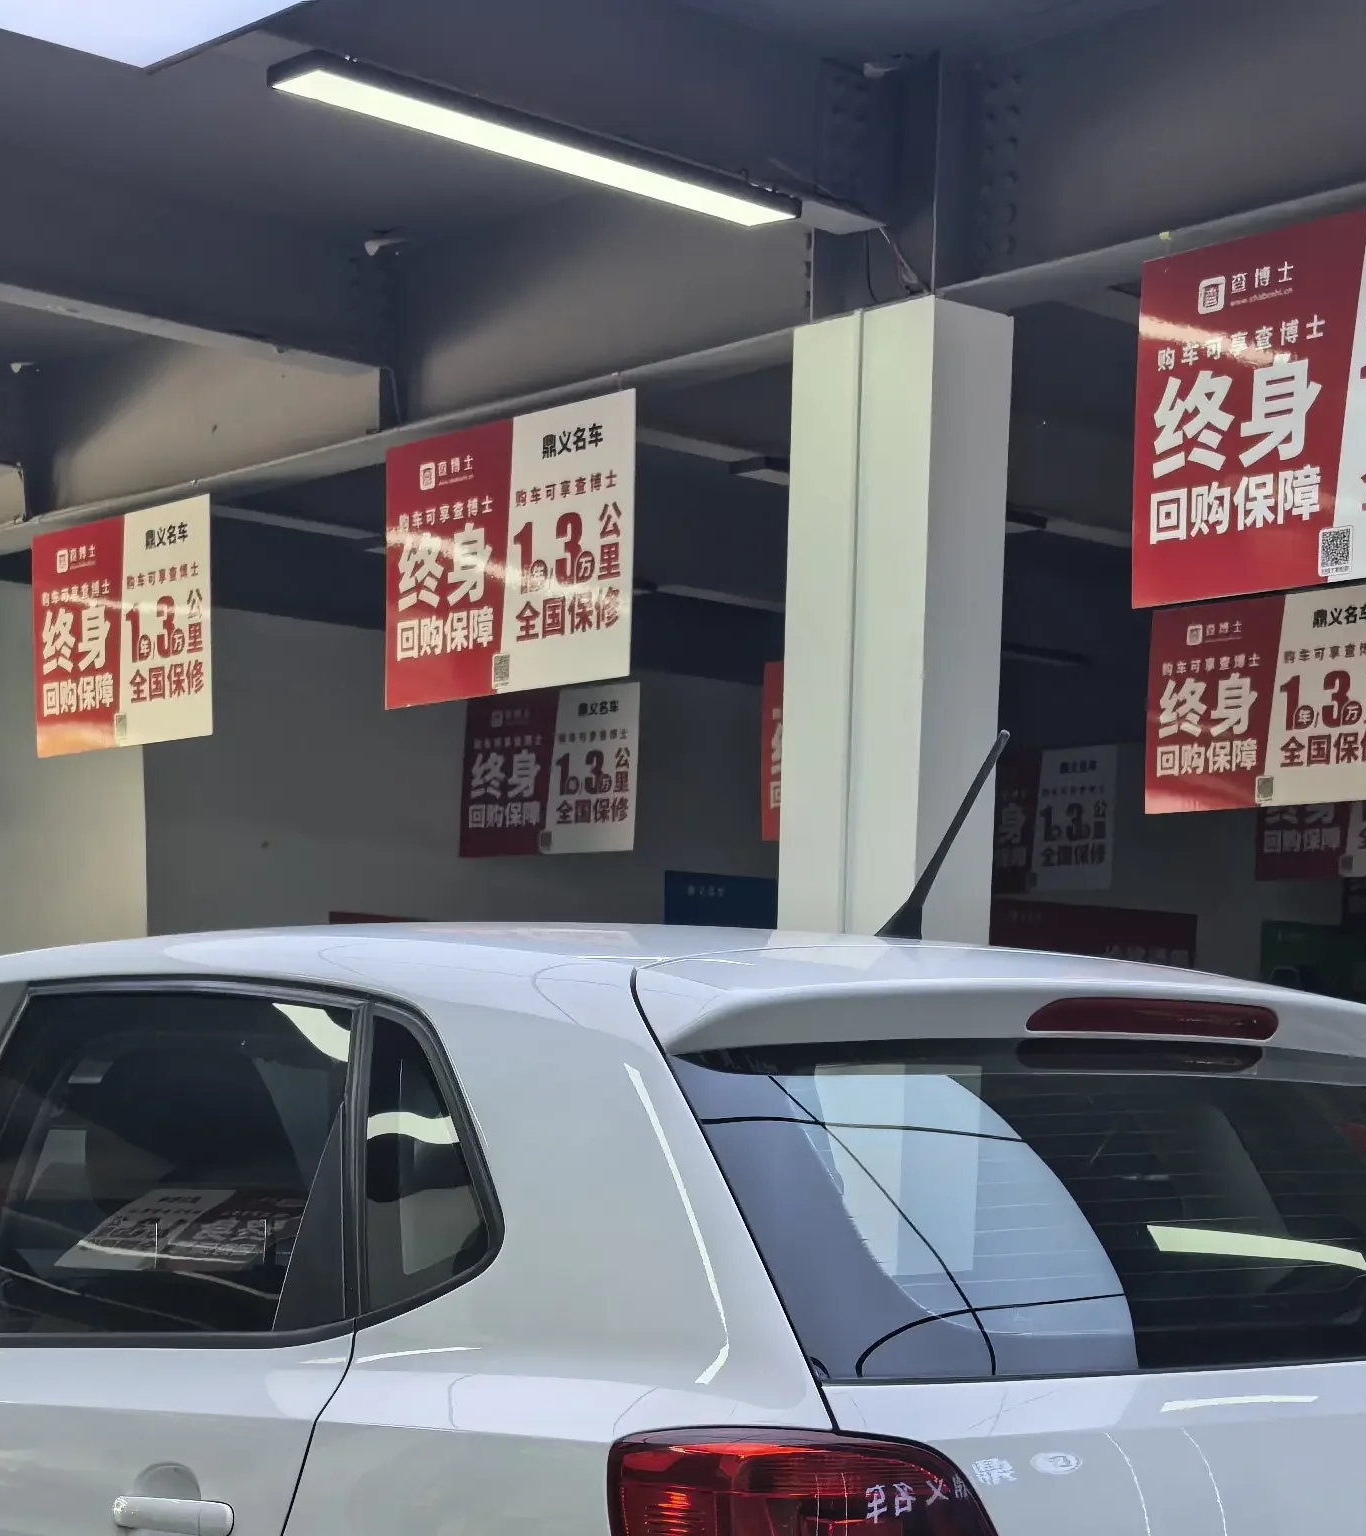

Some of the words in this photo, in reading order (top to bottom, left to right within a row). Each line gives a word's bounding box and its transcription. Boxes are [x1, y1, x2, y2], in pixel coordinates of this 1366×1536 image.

[1230, 261, 1294, 294] 查博士
[1157, 314, 1326, 372] 购车可享查博士
[1151, 352, 1324, 480] 终身
[542, 422, 604, 460] 鼎义名车
[515, 468, 617, 508] 购车可享查博士
[1147, 463, 1322, 546] 回购保障
[144, 521, 189, 551] 鼎义名车
[399, 494, 493, 532] 购车可享查博士
[126, 560, 199, 590] 购车可享查博士
[397, 521, 493, 612] 终身
[395, 604, 494, 662] 回购保障
[514, 585, 621, 642] 全国保修
[41, 600, 112, 676] 终身
[128, 658, 205, 704] 全国保修
[1161, 651, 1261, 676] 购车可享查博士
[41, 671, 114, 718] 回购保障
[1157, 672, 1259, 739] 终身
[469, 748, 542, 800] 终身
[1154, 737, 1258, 778] 回购保障
[555, 795, 629, 825] 全国保修
